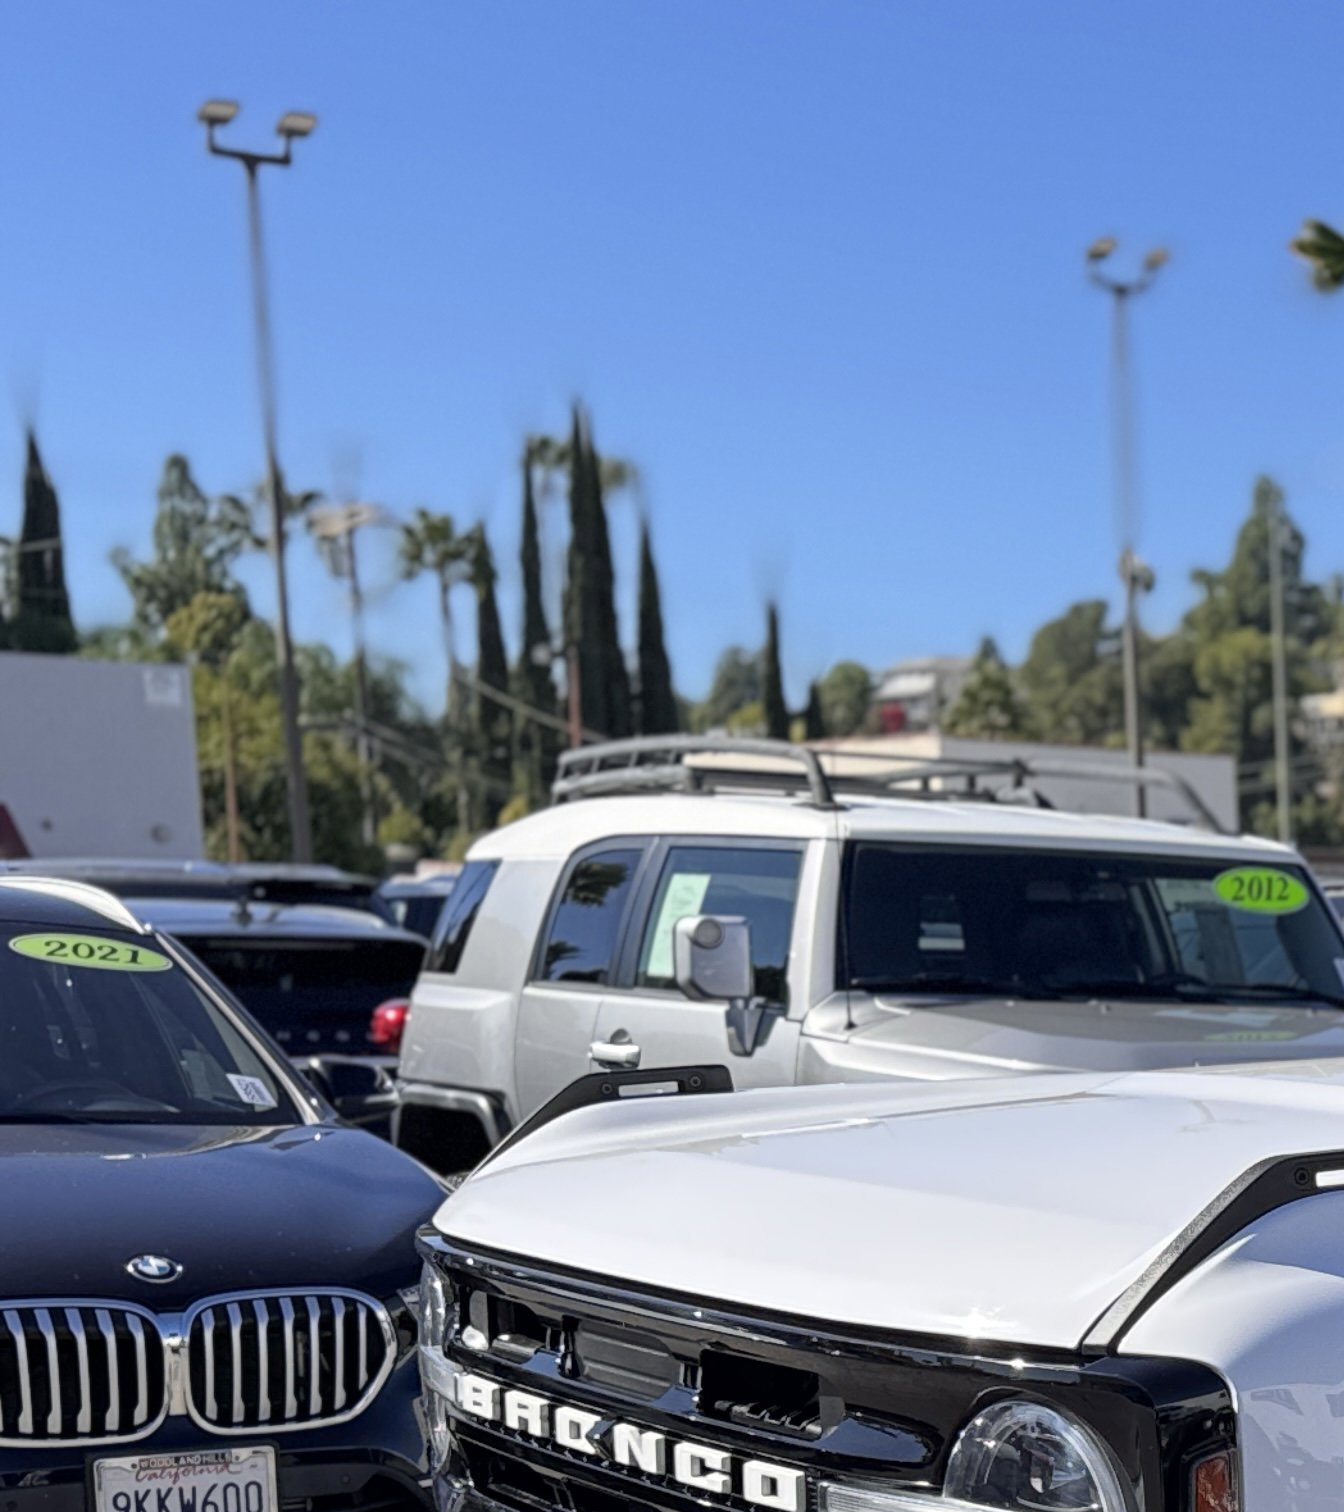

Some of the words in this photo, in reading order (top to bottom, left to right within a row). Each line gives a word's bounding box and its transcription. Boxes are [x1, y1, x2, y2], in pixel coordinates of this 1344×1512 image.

[1231, 875, 1290, 902] 2012
[44, 940, 144, 966] 2021
[140, 1456, 201, 1471] WOODLAND
